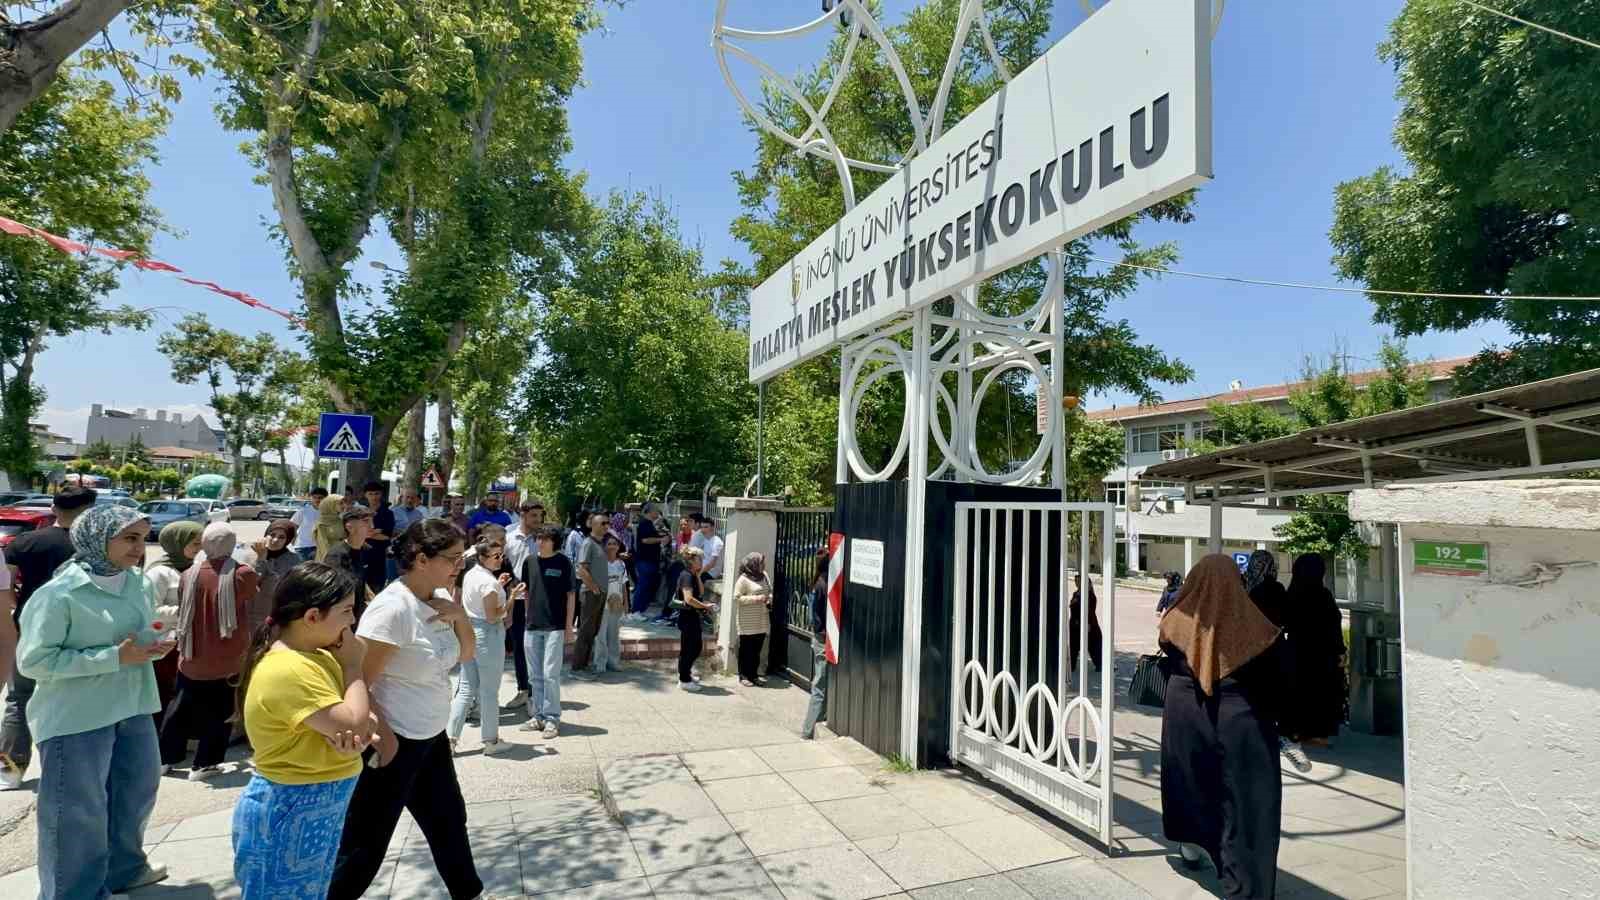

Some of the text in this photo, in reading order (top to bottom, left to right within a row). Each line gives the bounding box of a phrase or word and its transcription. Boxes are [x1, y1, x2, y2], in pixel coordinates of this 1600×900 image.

[752, 93, 1170, 369] MALATYA MESLEK YÜKSEKOKULU
[806, 115, 1004, 290] İNÖNÜ ÜNİVERSİTESİ
[1434, 546, 1461, 560] 192
